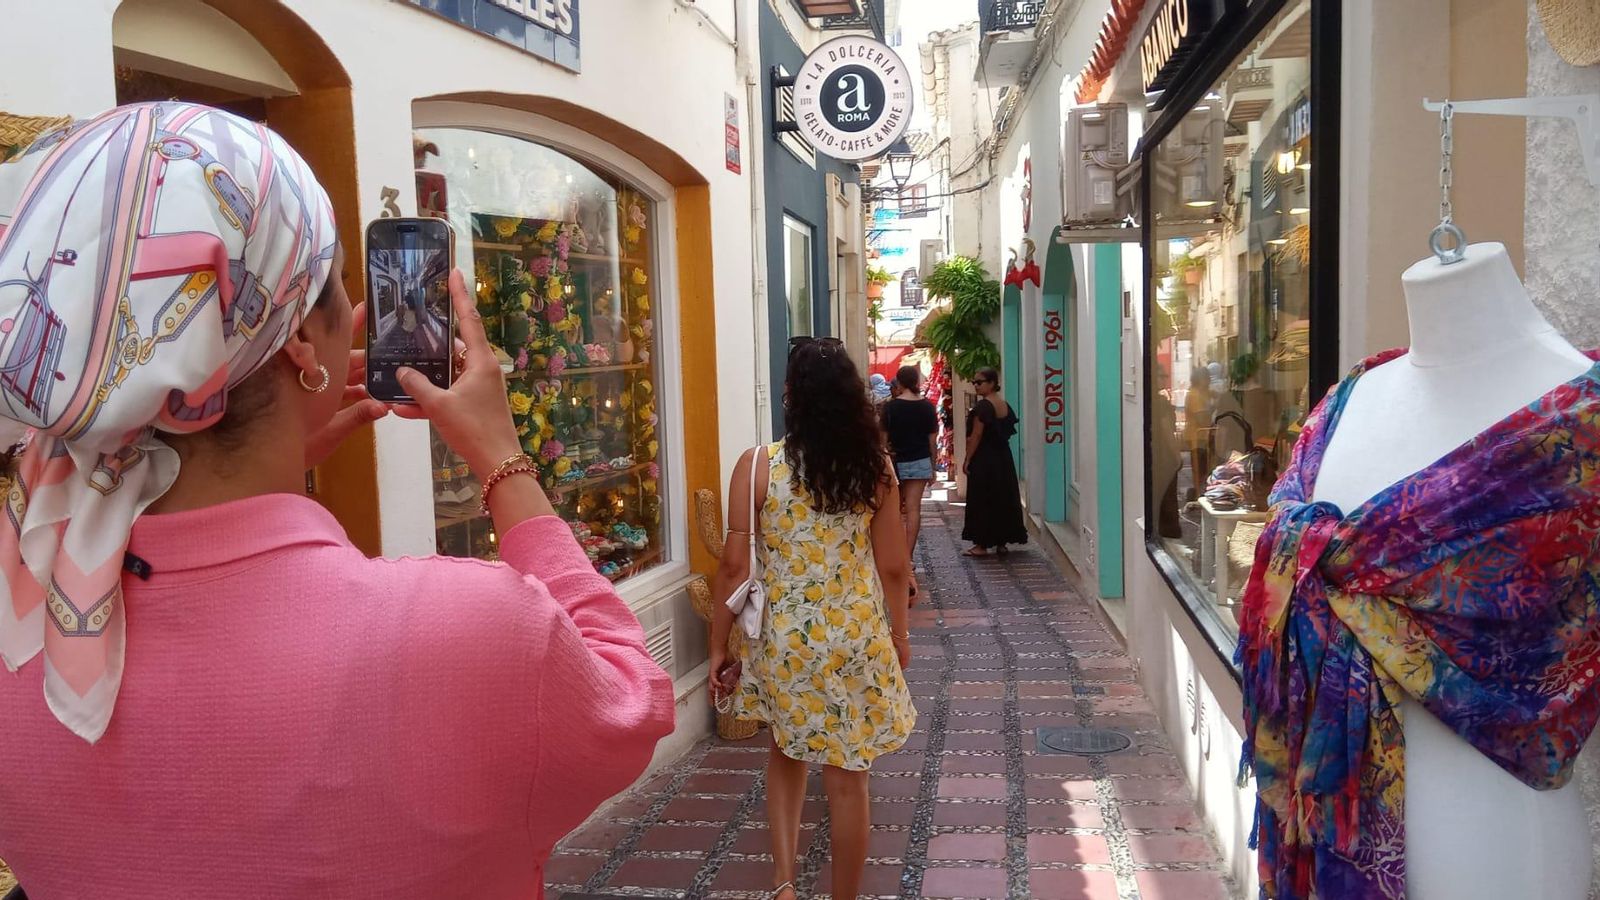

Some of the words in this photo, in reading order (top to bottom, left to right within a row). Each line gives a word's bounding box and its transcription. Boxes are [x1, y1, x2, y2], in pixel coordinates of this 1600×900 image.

[807, 61, 825, 80] LA
[828, 45, 896, 76] DOLCERIA
[1140, 0, 1189, 94] ABANICO
[837, 73, 872, 112] a
[837, 112, 870, 122] ROMA
[874, 132, 884, 142] &
[880, 106, 903, 136] MORE
[380, 185, 402, 218] 3
[1043, 310, 1064, 352] 1961
[1044, 363, 1065, 444] STORY
